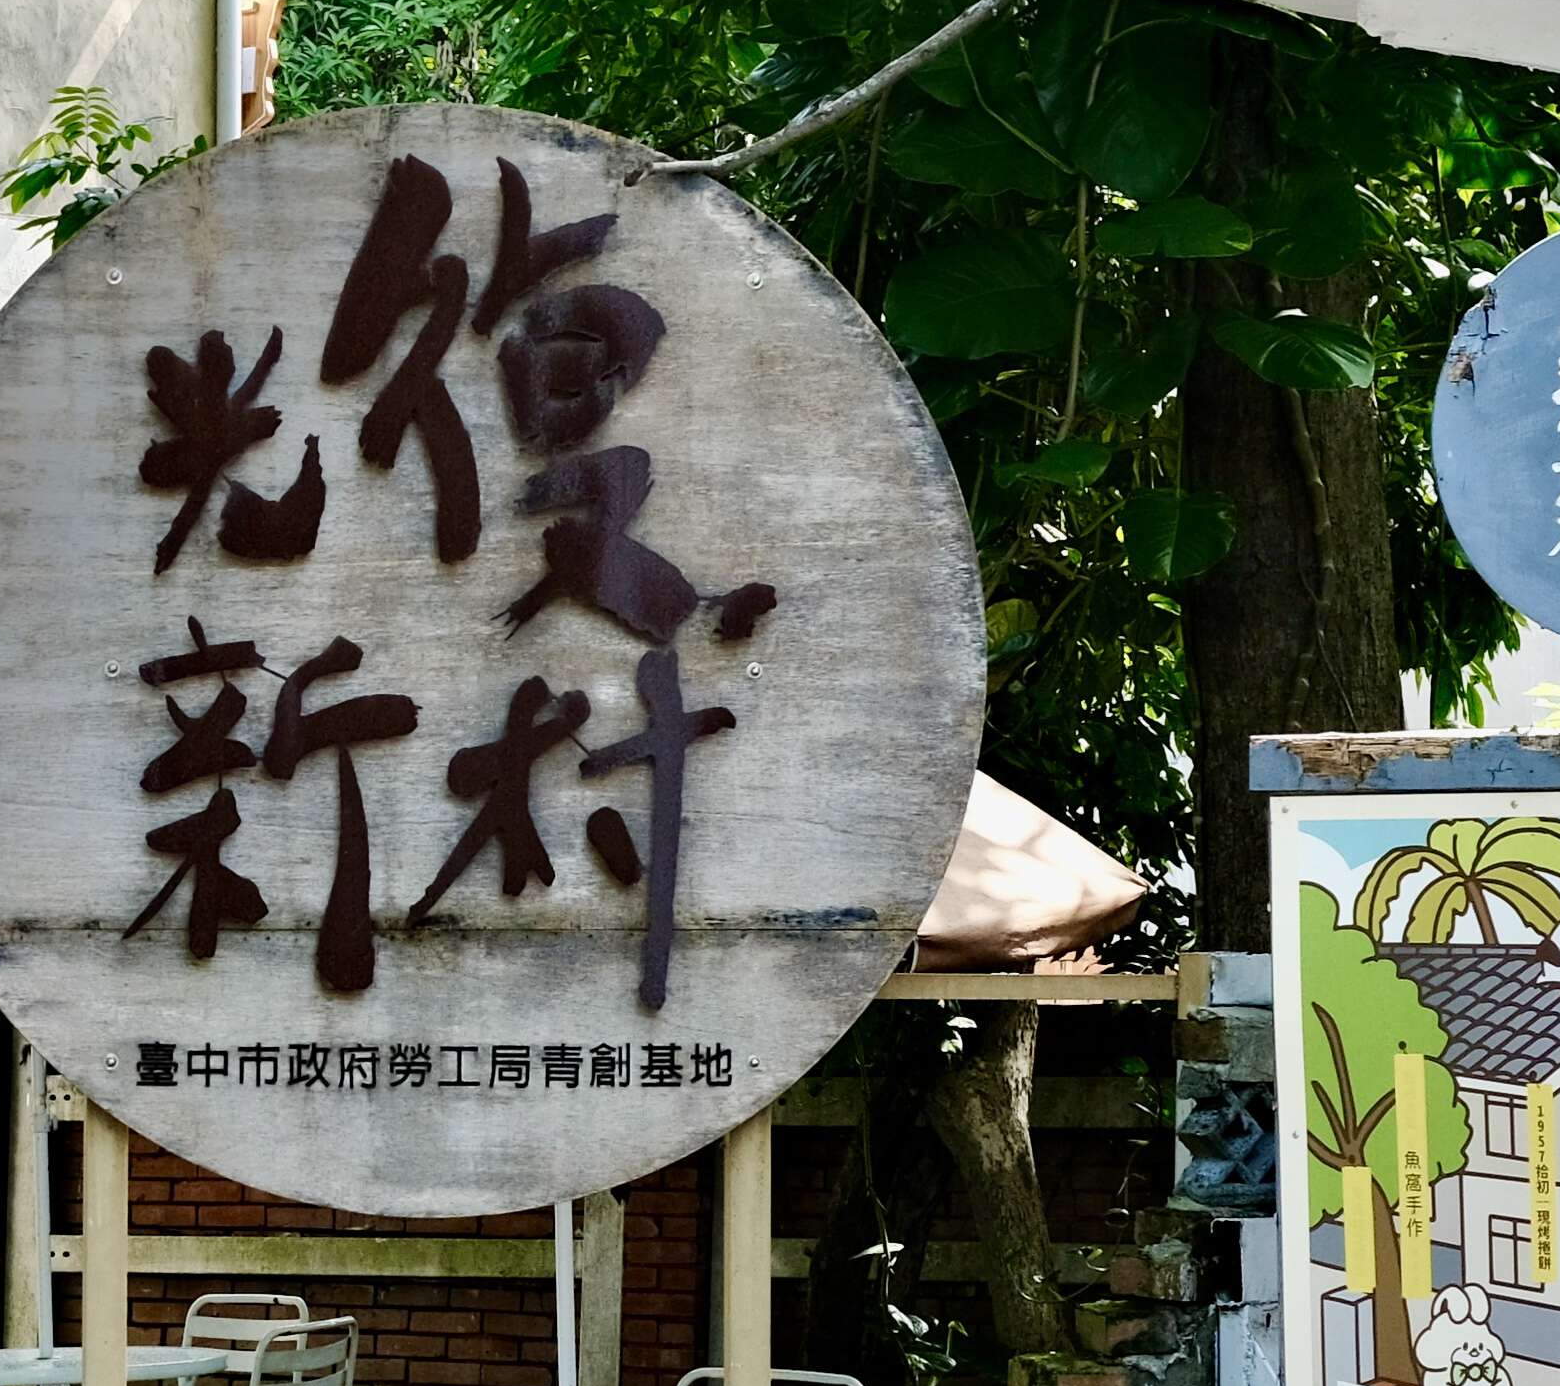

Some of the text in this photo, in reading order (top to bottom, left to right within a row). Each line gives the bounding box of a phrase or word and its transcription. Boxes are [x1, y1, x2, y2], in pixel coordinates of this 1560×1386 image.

[139, 152, 777, 642] 光復
[122, 614, 735, 1011] 新村
[136, 1043, 733, 1089] 臺中市政府勞工局青創基地
